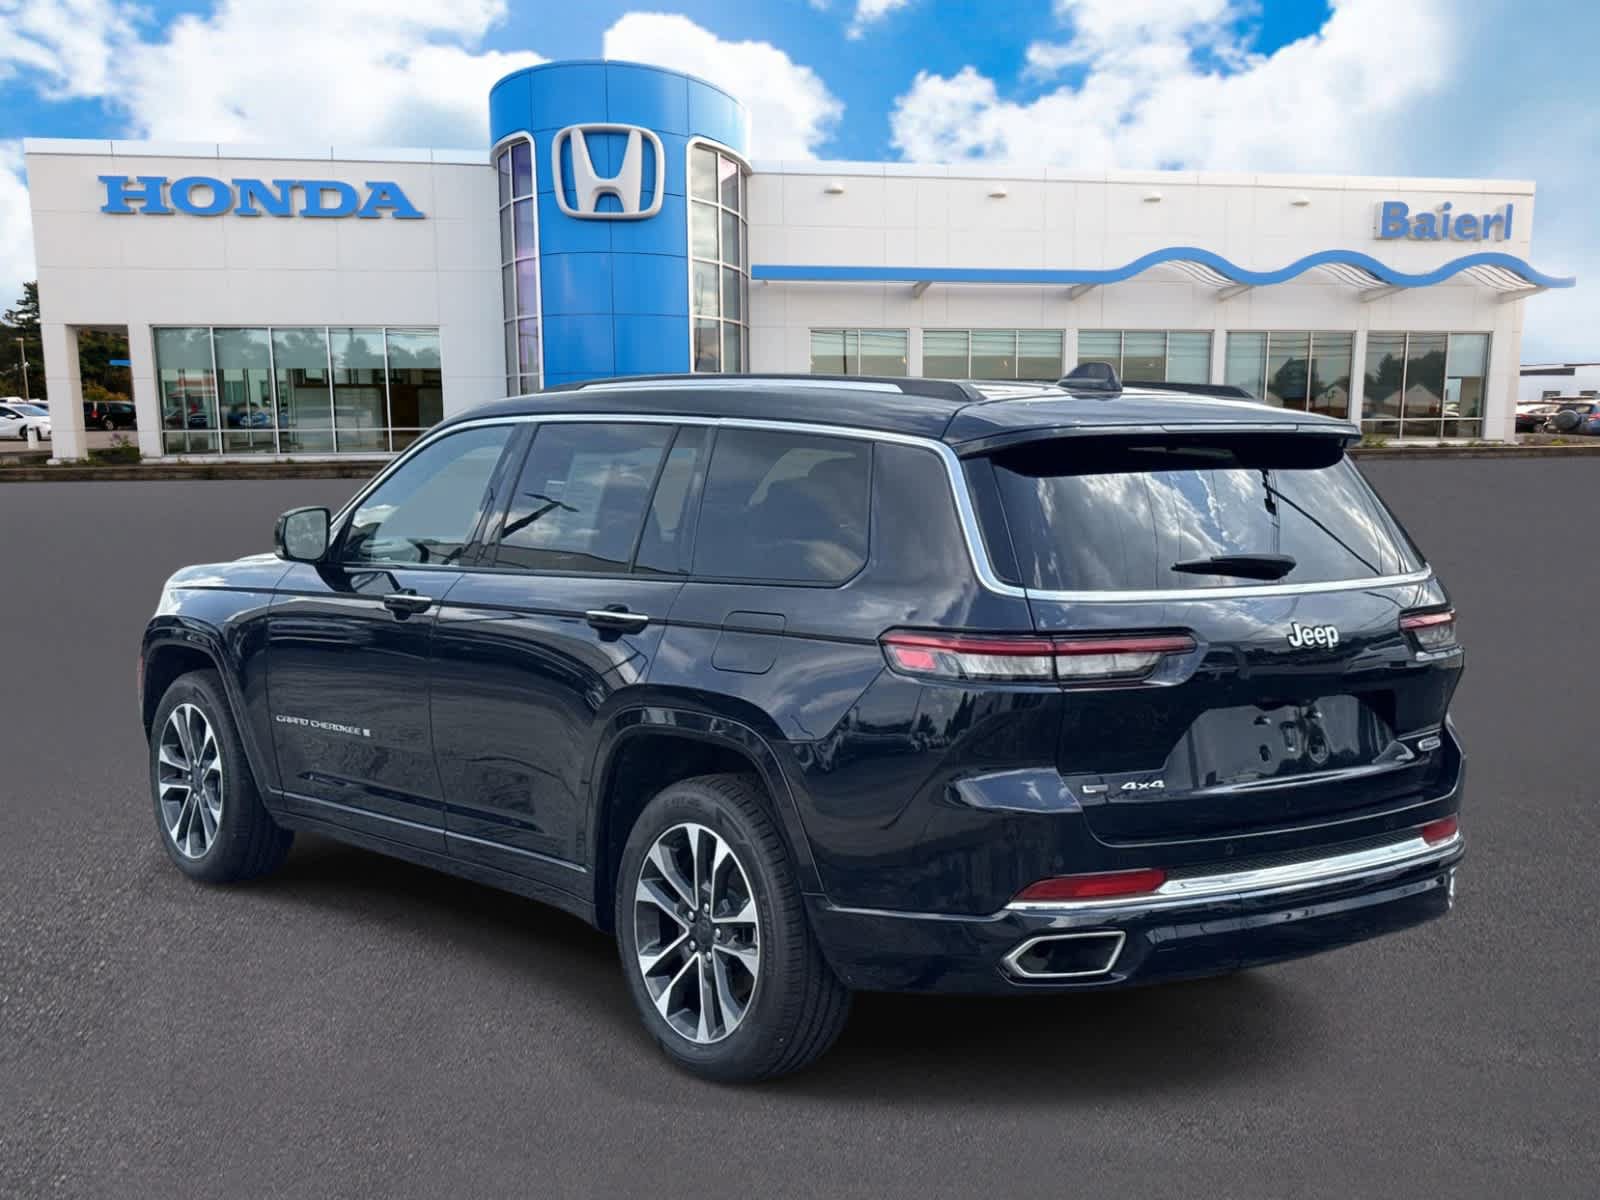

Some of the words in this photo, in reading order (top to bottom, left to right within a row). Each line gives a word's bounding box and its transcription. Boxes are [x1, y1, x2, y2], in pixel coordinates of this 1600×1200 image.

[98, 176, 425, 219] HONDA
[1380, 201, 1514, 240] Baierl
[1287, 622, 1339, 648] Jeep
[1120, 779, 1165, 791] 4x4
